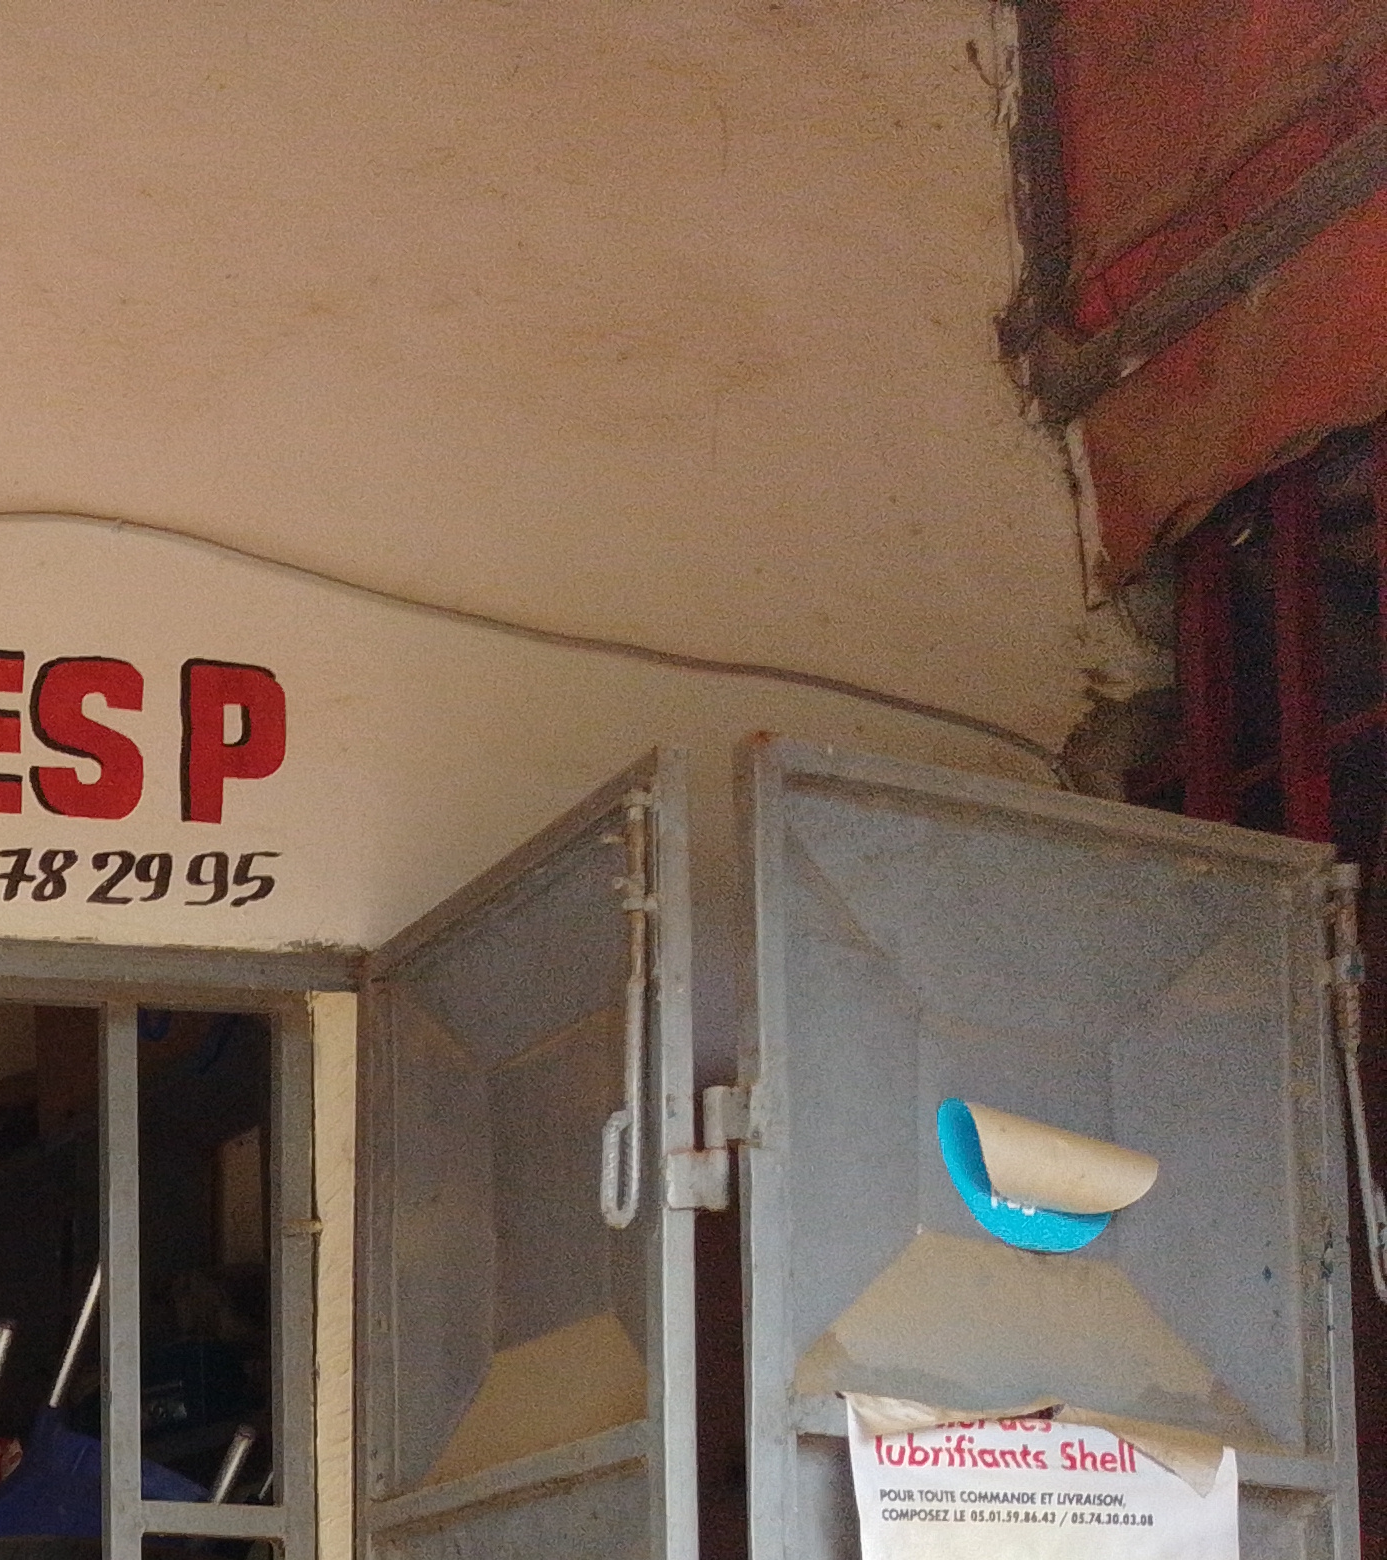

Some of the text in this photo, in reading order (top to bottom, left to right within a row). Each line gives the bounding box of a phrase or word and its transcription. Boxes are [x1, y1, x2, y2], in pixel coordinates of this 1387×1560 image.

[181, 657, 287, 824] P
[875, 1433, 1136, 1473] lubrifiants Shell
[880, 1489, 915, 1502] POUR
[917, 1490, 957, 1503] TOUTE
[959, 1490, 1037, 1505] COMMANDE
[1040, 1492, 1054, 1505] ET
[882, 1508, 950, 1522] COMPOSEZ
[953, 1510, 966, 1522] LE
